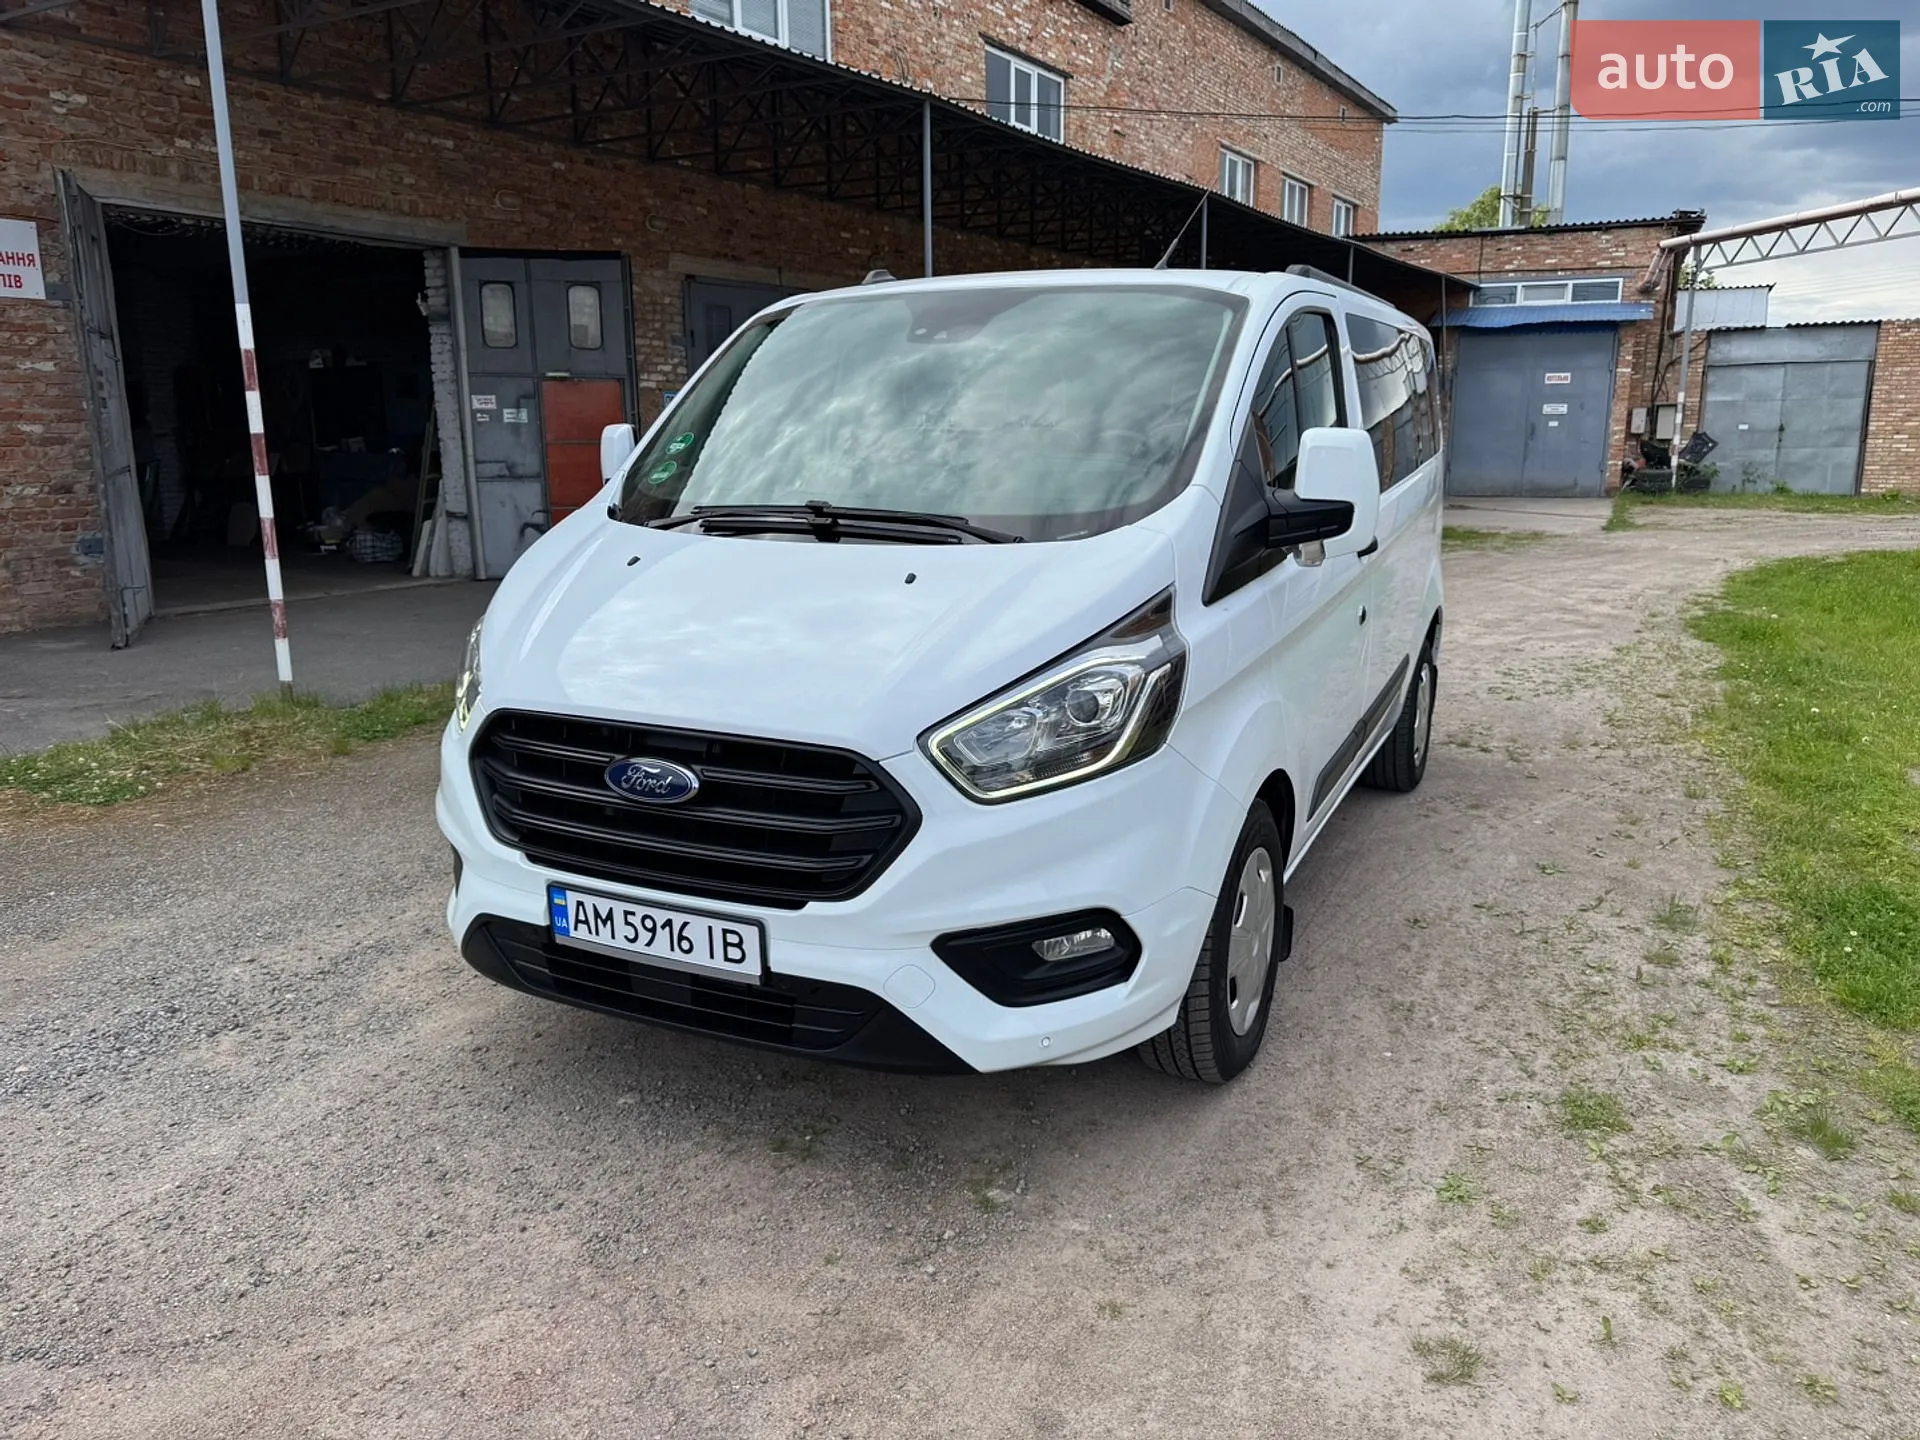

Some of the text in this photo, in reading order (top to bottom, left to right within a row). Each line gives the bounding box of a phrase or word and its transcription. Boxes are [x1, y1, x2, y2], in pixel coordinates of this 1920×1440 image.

[621, 763, 672, 794] Ford
[555, 916, 568, 929] UA
[573, 900, 746, 964] AM 5916 IB
